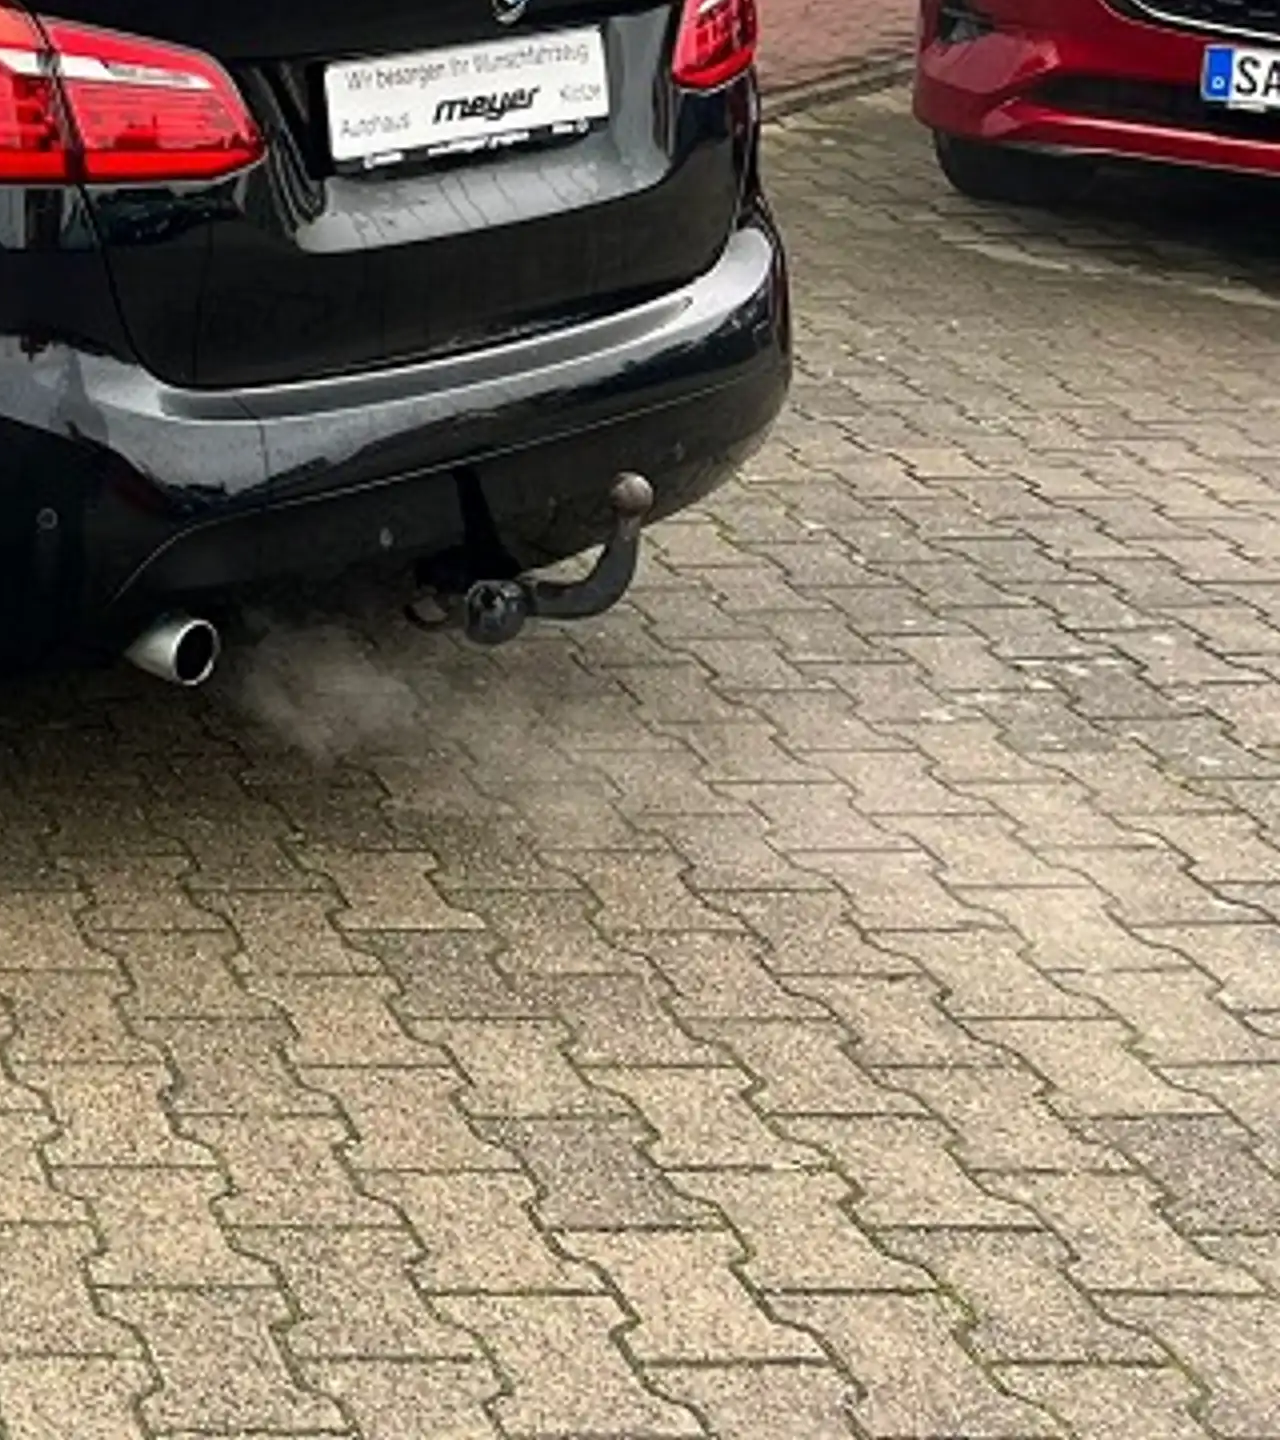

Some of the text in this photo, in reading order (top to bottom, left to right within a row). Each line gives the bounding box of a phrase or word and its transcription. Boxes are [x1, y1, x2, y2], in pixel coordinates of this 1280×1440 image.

[345, 68, 372, 91] Wir
[376, 63, 446, 90] besorgen
[432, 87, 540, 124] meyer
